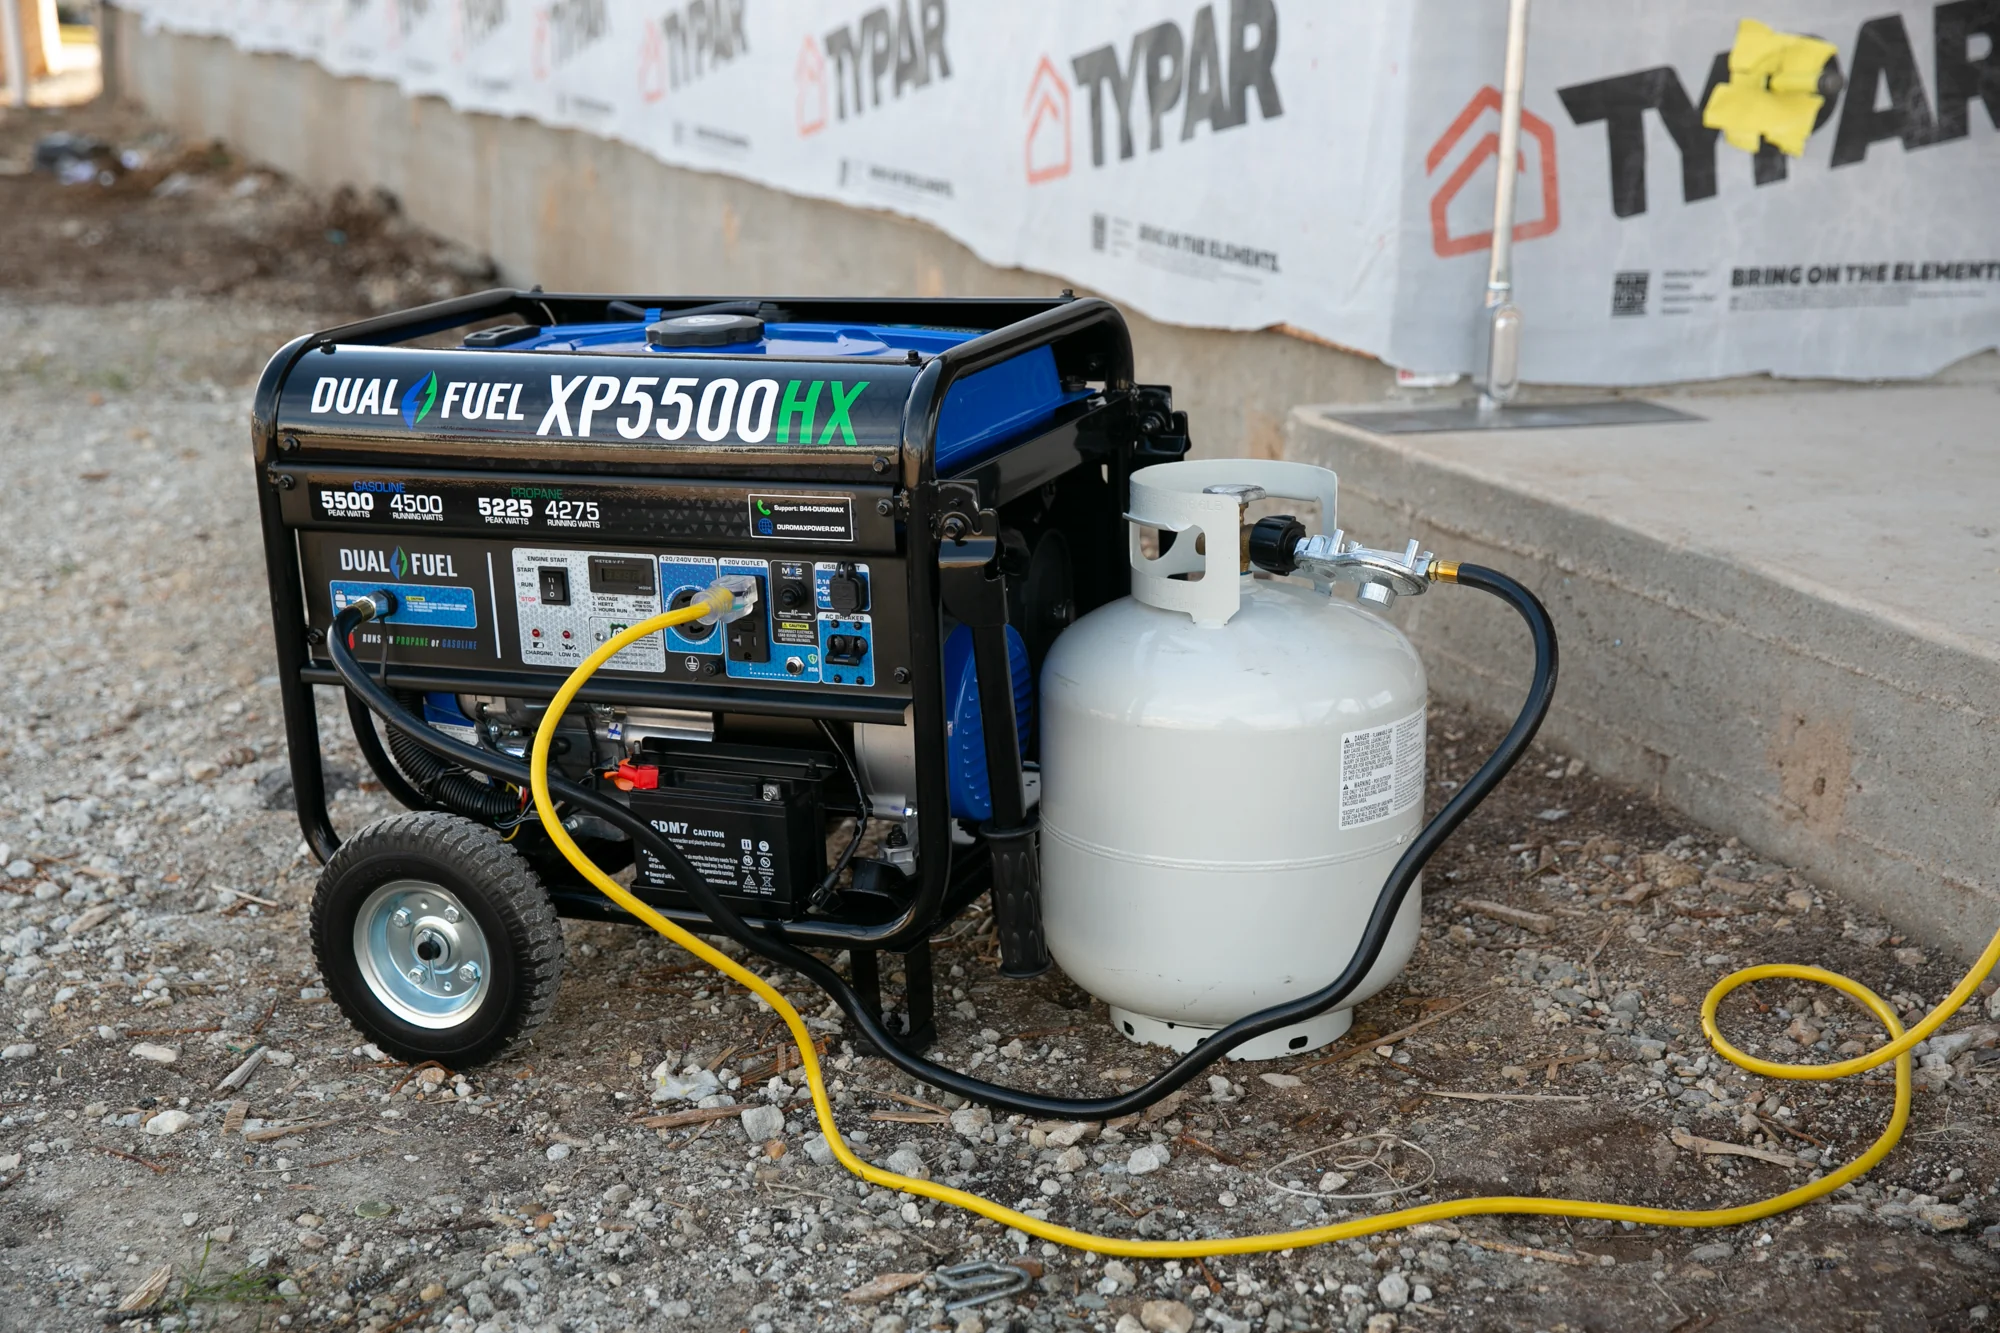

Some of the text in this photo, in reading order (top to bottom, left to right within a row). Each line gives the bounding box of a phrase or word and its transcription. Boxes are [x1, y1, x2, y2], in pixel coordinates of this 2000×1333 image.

[824, 0, 952, 122] TYPAR
[1071, 0, 1284, 168] TYPAR
[1730, 267, 1801, 288] BRING
[1807, 265, 1841, 285] ON
[1845, 263, 1888, 283] THE
[310, 374, 871, 446] DUAL FUEL XP5500HX
[353, 481, 406, 494] GASOLINE
[511, 487, 564, 500] PROPANE
[320, 490, 443, 514] 5500 4500
[774, 504, 844, 513] Support: 844-DUROMAX
[327, 509, 443, 521] PEAK WATTS RUNNING WATTS
[478, 497, 600, 521] 5225 4275
[485, 516, 600, 528] PEAK WATTS RUNNING WATTS
[776, 523, 845, 533] DUROMAXPOWER.COM
[339, 548, 458, 577] DUAL FUEL
[362, 633, 381, 644] RUNS
[395, 636, 429, 647] PROPANE
[431, 639, 440, 648] or
[442, 639, 477, 650] GASOLINE
[1354, 733, 1370, 742] DANGER
[1354, 780, 1371, 788] WARNING
[692, 828, 725, 838] CAUTION
